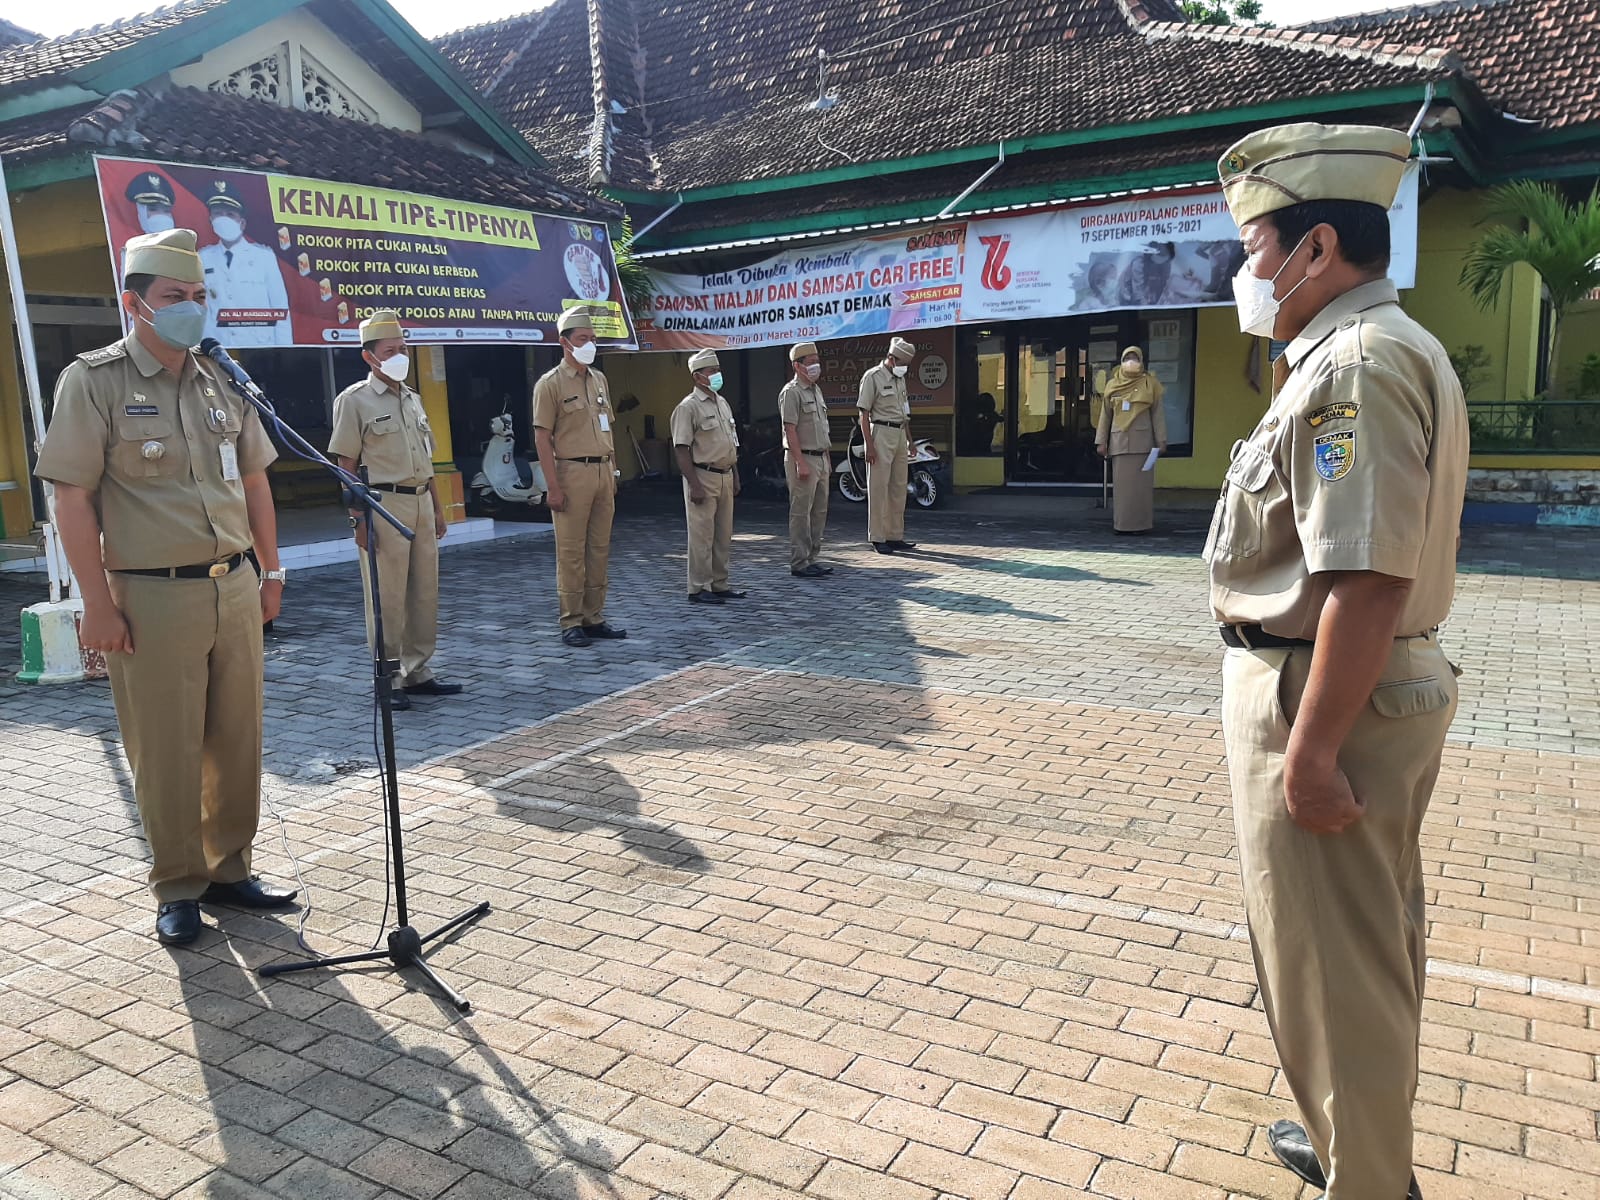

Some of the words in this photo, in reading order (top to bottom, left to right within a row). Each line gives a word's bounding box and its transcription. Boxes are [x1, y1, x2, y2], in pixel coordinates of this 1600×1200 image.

[278, 187, 378, 221] KENALI
[384, 199, 534, 241] TIPE-TIPENYA
[1080, 212, 1137, 229] DIRGAHAYU
[1139, 207, 1179, 221] PALANG
[1181, 202, 1218, 217] MERAH
[1080, 232, 1090, 244] 17
[1092, 225, 1148, 242] SEPTEMBER
[1151, 219, 1201, 235] 1945-2021
[297, 234, 343, 248] ROKOK
[346, 238, 373, 250] PITA
[375, 239, 412, 253] CUKAI
[415, 242, 448, 255] PALSU
[316, 259, 360, 273] ROKOK
[364, 261, 391, 274] PITA
[394, 262, 430, 276] CUKAI
[433, 265, 479, 279] BERBEDA
[702, 271, 734, 289] Telah
[737, 263, 788, 285] Dibuka
[795, 251, 852, 275] Kembali
[338, 284, 384, 297] ROKOK
[387, 285, 414, 297] PITA
[417, 285, 451, 297] CUKAI
[453, 287, 487, 299] BEKAS
[655, 294, 710, 311] SAMSAT
[713, 287, 764, 311] MALAM
[767, 281, 798, 303] DAN
[802, 270, 865, 298] SAMSAT
[869, 265, 904, 288] CAR
[909, 256, 953, 281] FREE
[910, 289, 941, 301] SAMSAT
[942, 287, 960, 297] CAR
[406, 307, 445, 319] POLOS
[448, 307, 476, 319] ATAU
[481, 308, 513, 320] TANPA
[515, 310, 535, 321] PITA
[664, 316, 736, 331] DIHALAMAN
[738, 307, 785, 327] KANTOR
[788, 300, 840, 320] SAMSAT
[844, 291, 892, 313] DEMAK
[929, 304, 946, 312] Hari
[727, 335, 751, 345] Mulai
[753, 333, 764, 342] 01
[767, 329, 793, 340] Maret
[799, 326, 820, 337] 2021
[1319, 432, 1350, 444] DEMAK
